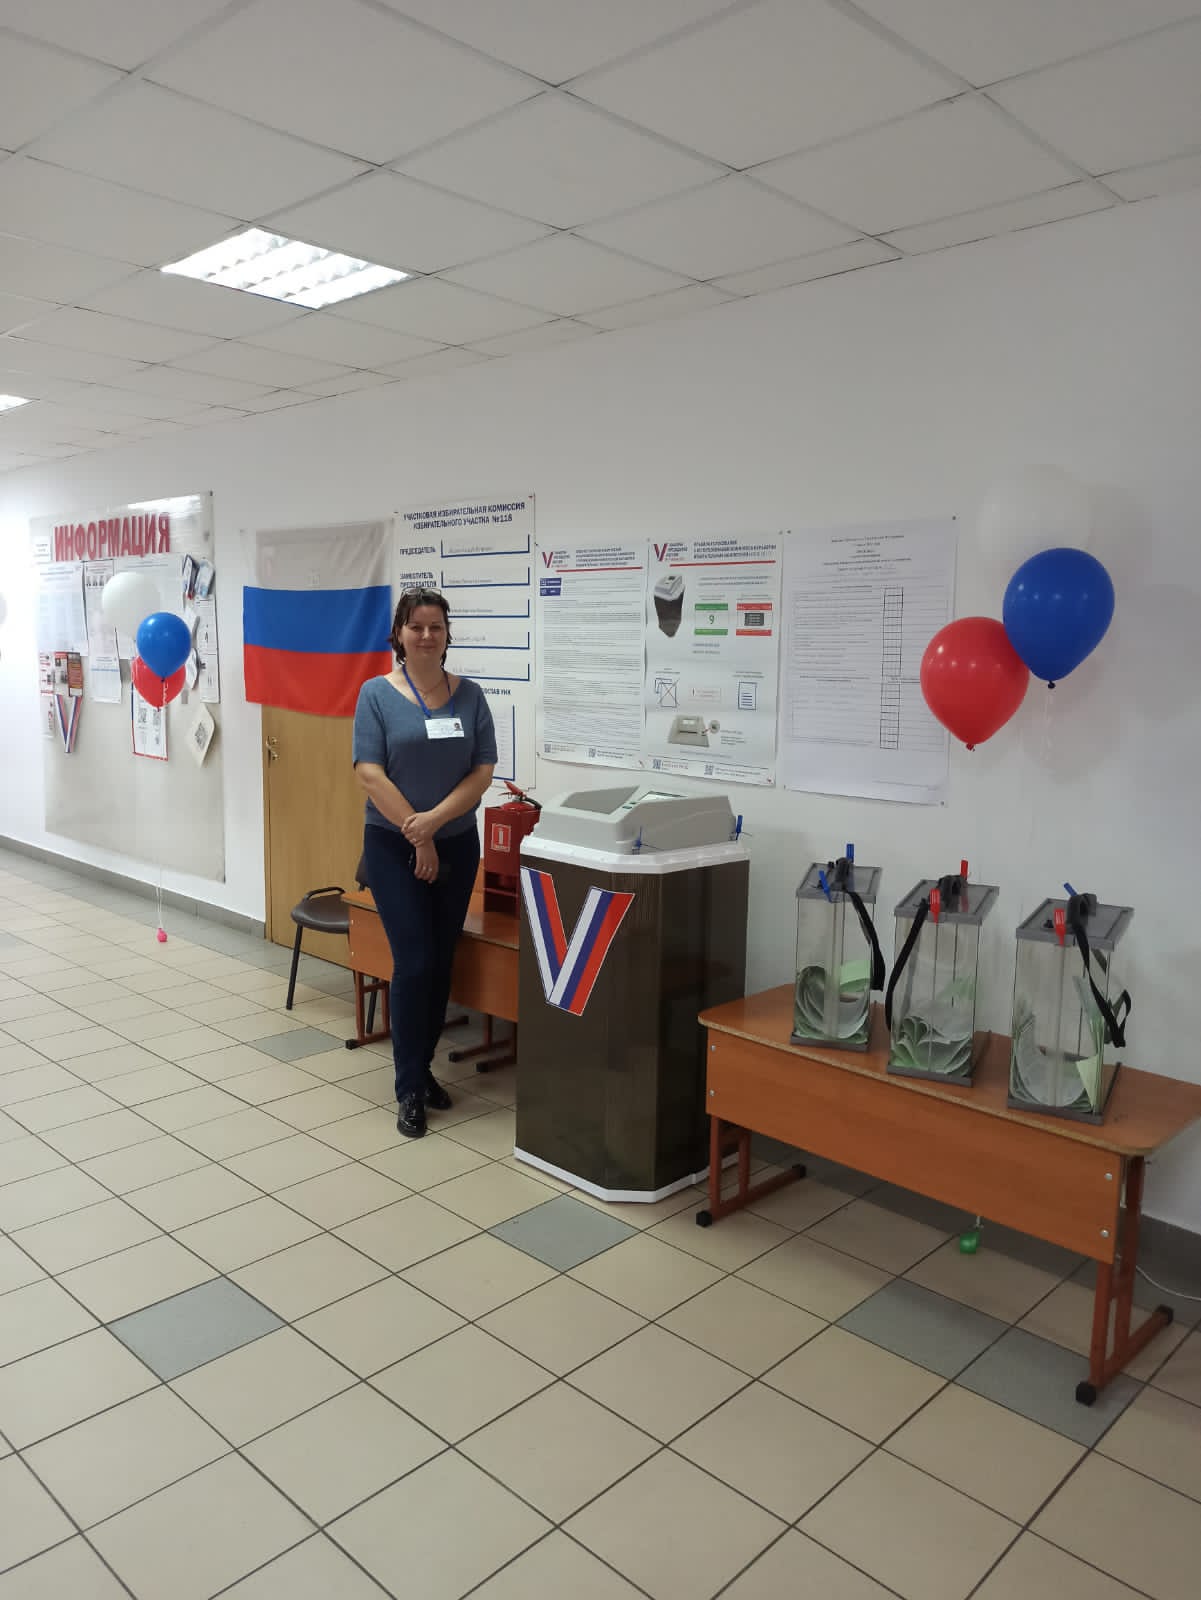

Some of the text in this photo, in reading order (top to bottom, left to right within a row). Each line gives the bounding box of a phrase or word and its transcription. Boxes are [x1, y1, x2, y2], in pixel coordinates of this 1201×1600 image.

[403, 502, 525, 521] УЧАСТКОВАЯ ИЗБИРАТЕЛЬНАЯ КОМИССИЯ
[413, 518, 463, 530] ИЗБИРАТЕЛЬНОГО
[463, 515, 490, 526] УЧАСТКА
[54, 512, 170, 562] ИНФОРМАЦИЯ
[399, 546, 436, 556] ПРЕДСЕДАТЕЛЬ
